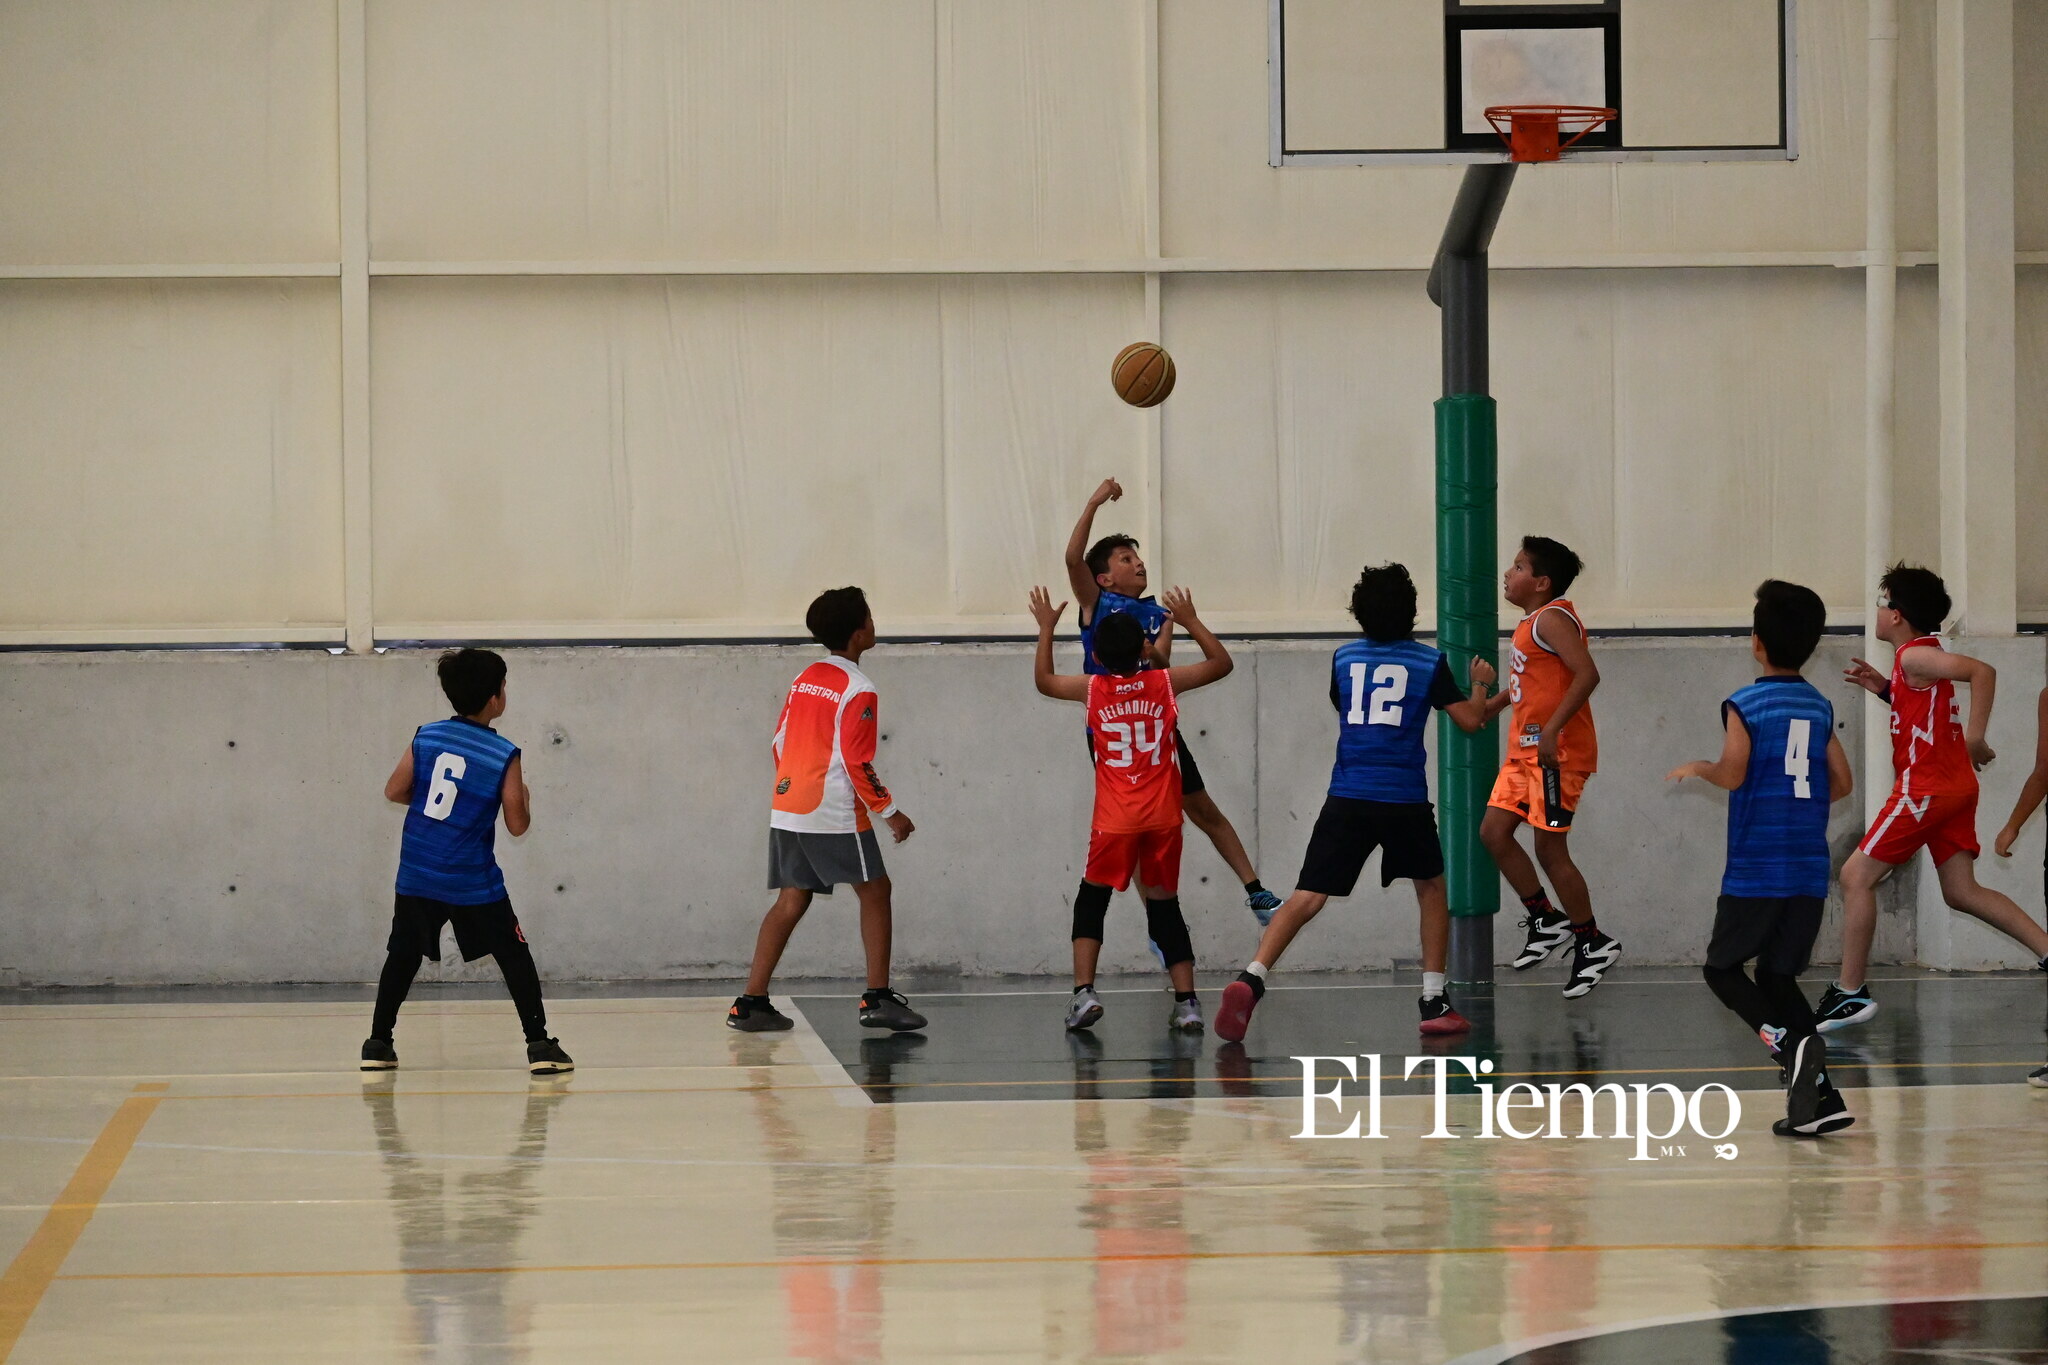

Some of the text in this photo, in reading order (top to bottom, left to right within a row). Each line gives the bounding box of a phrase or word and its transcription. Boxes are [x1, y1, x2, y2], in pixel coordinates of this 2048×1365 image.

[1097, 700, 1164, 723] DELGADILLO
[1115, 680, 1145, 693] ROCA
[1347, 662, 1409, 727] 12
[1101, 719, 1164, 768] 34
[1785, 718, 1811, 799] 4
[423, 751, 467, 821] 6
